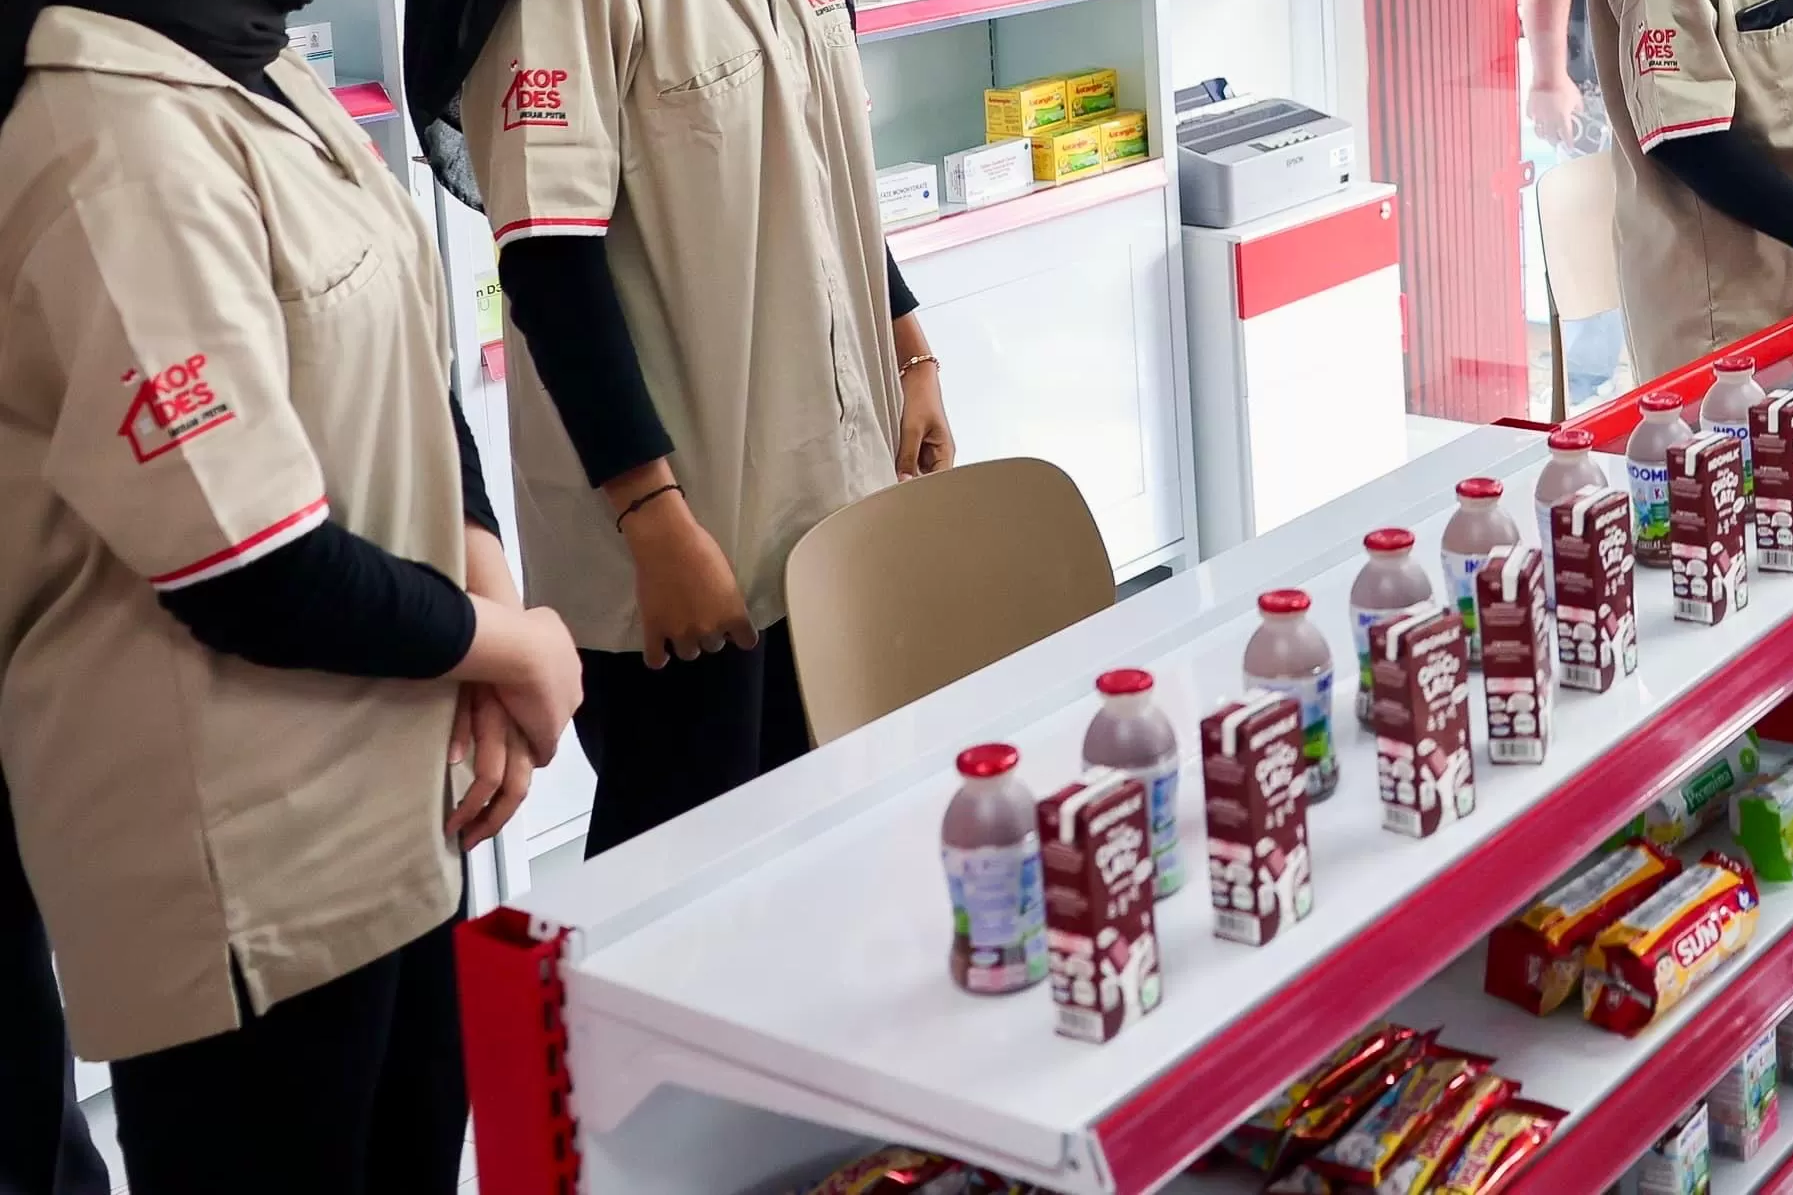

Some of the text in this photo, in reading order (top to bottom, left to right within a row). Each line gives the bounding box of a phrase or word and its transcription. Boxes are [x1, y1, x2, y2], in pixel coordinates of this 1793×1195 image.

[1646, 29, 1676, 43] KOP
[1647, 45, 1674, 59] DES
[519, 69, 567, 88] KOP
[519, 90, 561, 109] DES
[150, 354, 207, 402] KOP
[154, 383, 214, 425] DES
[1678, 919, 1720, 968] SUN
